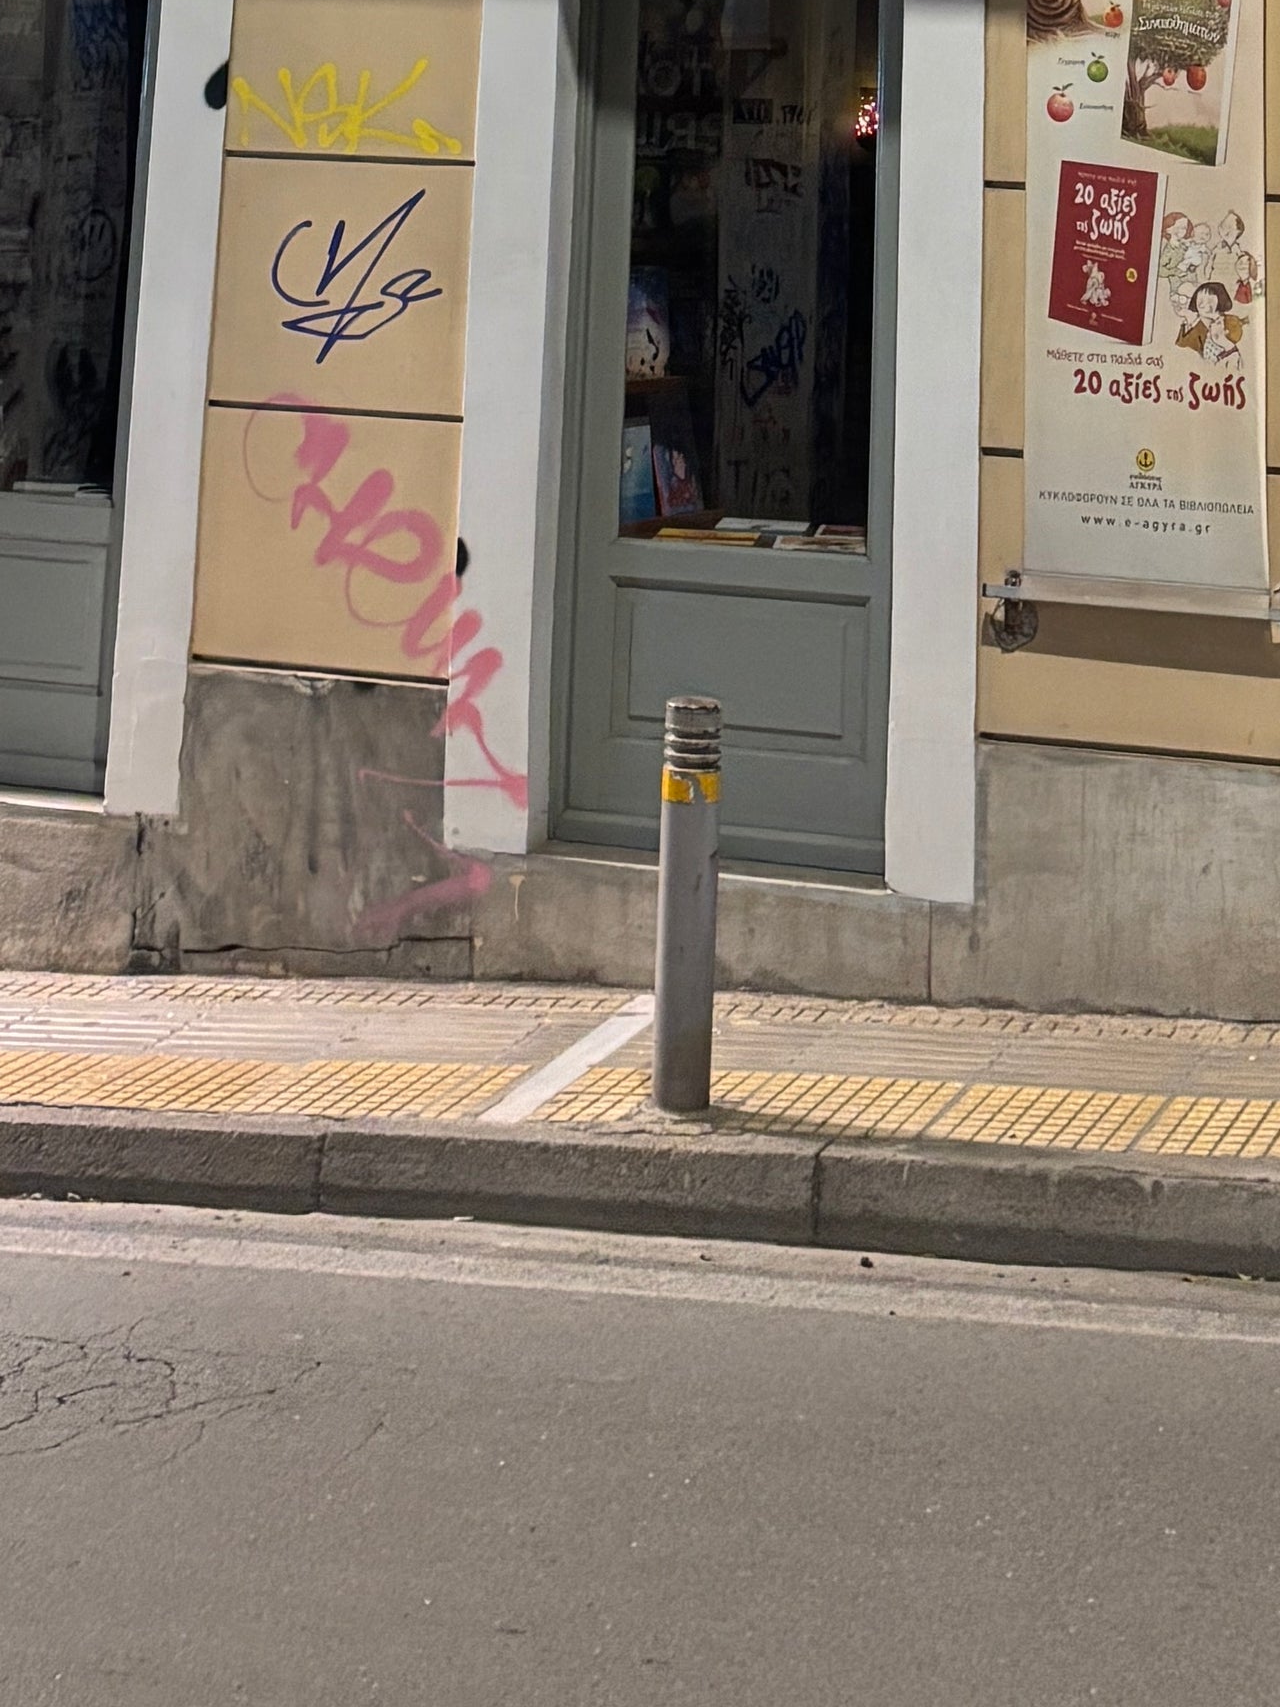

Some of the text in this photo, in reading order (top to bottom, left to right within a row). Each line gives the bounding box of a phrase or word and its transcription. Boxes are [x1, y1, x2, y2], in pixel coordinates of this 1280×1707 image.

[1074, 182, 1138, 217] 20 αξίες
[1090, 208, 1130, 244] ζωής
[1046, 349, 1164, 369] Μάθετε στα παιδιά σας
[1073, 368, 1247, 411] 20 αξίες της ζωής
[1039, 490, 1118, 506] ΚΥΚΛΟΦΟΡΟΥΝ
[1121, 495, 1133, 507] ΣΕ
[1163, 498, 1176, 509] ΤΑ
[1179, 500, 1254, 515] ΒΙΒΛΙΟΠΩΛΕΙΑ
[1081, 515, 1211, 535] www.e-agyra.gr
